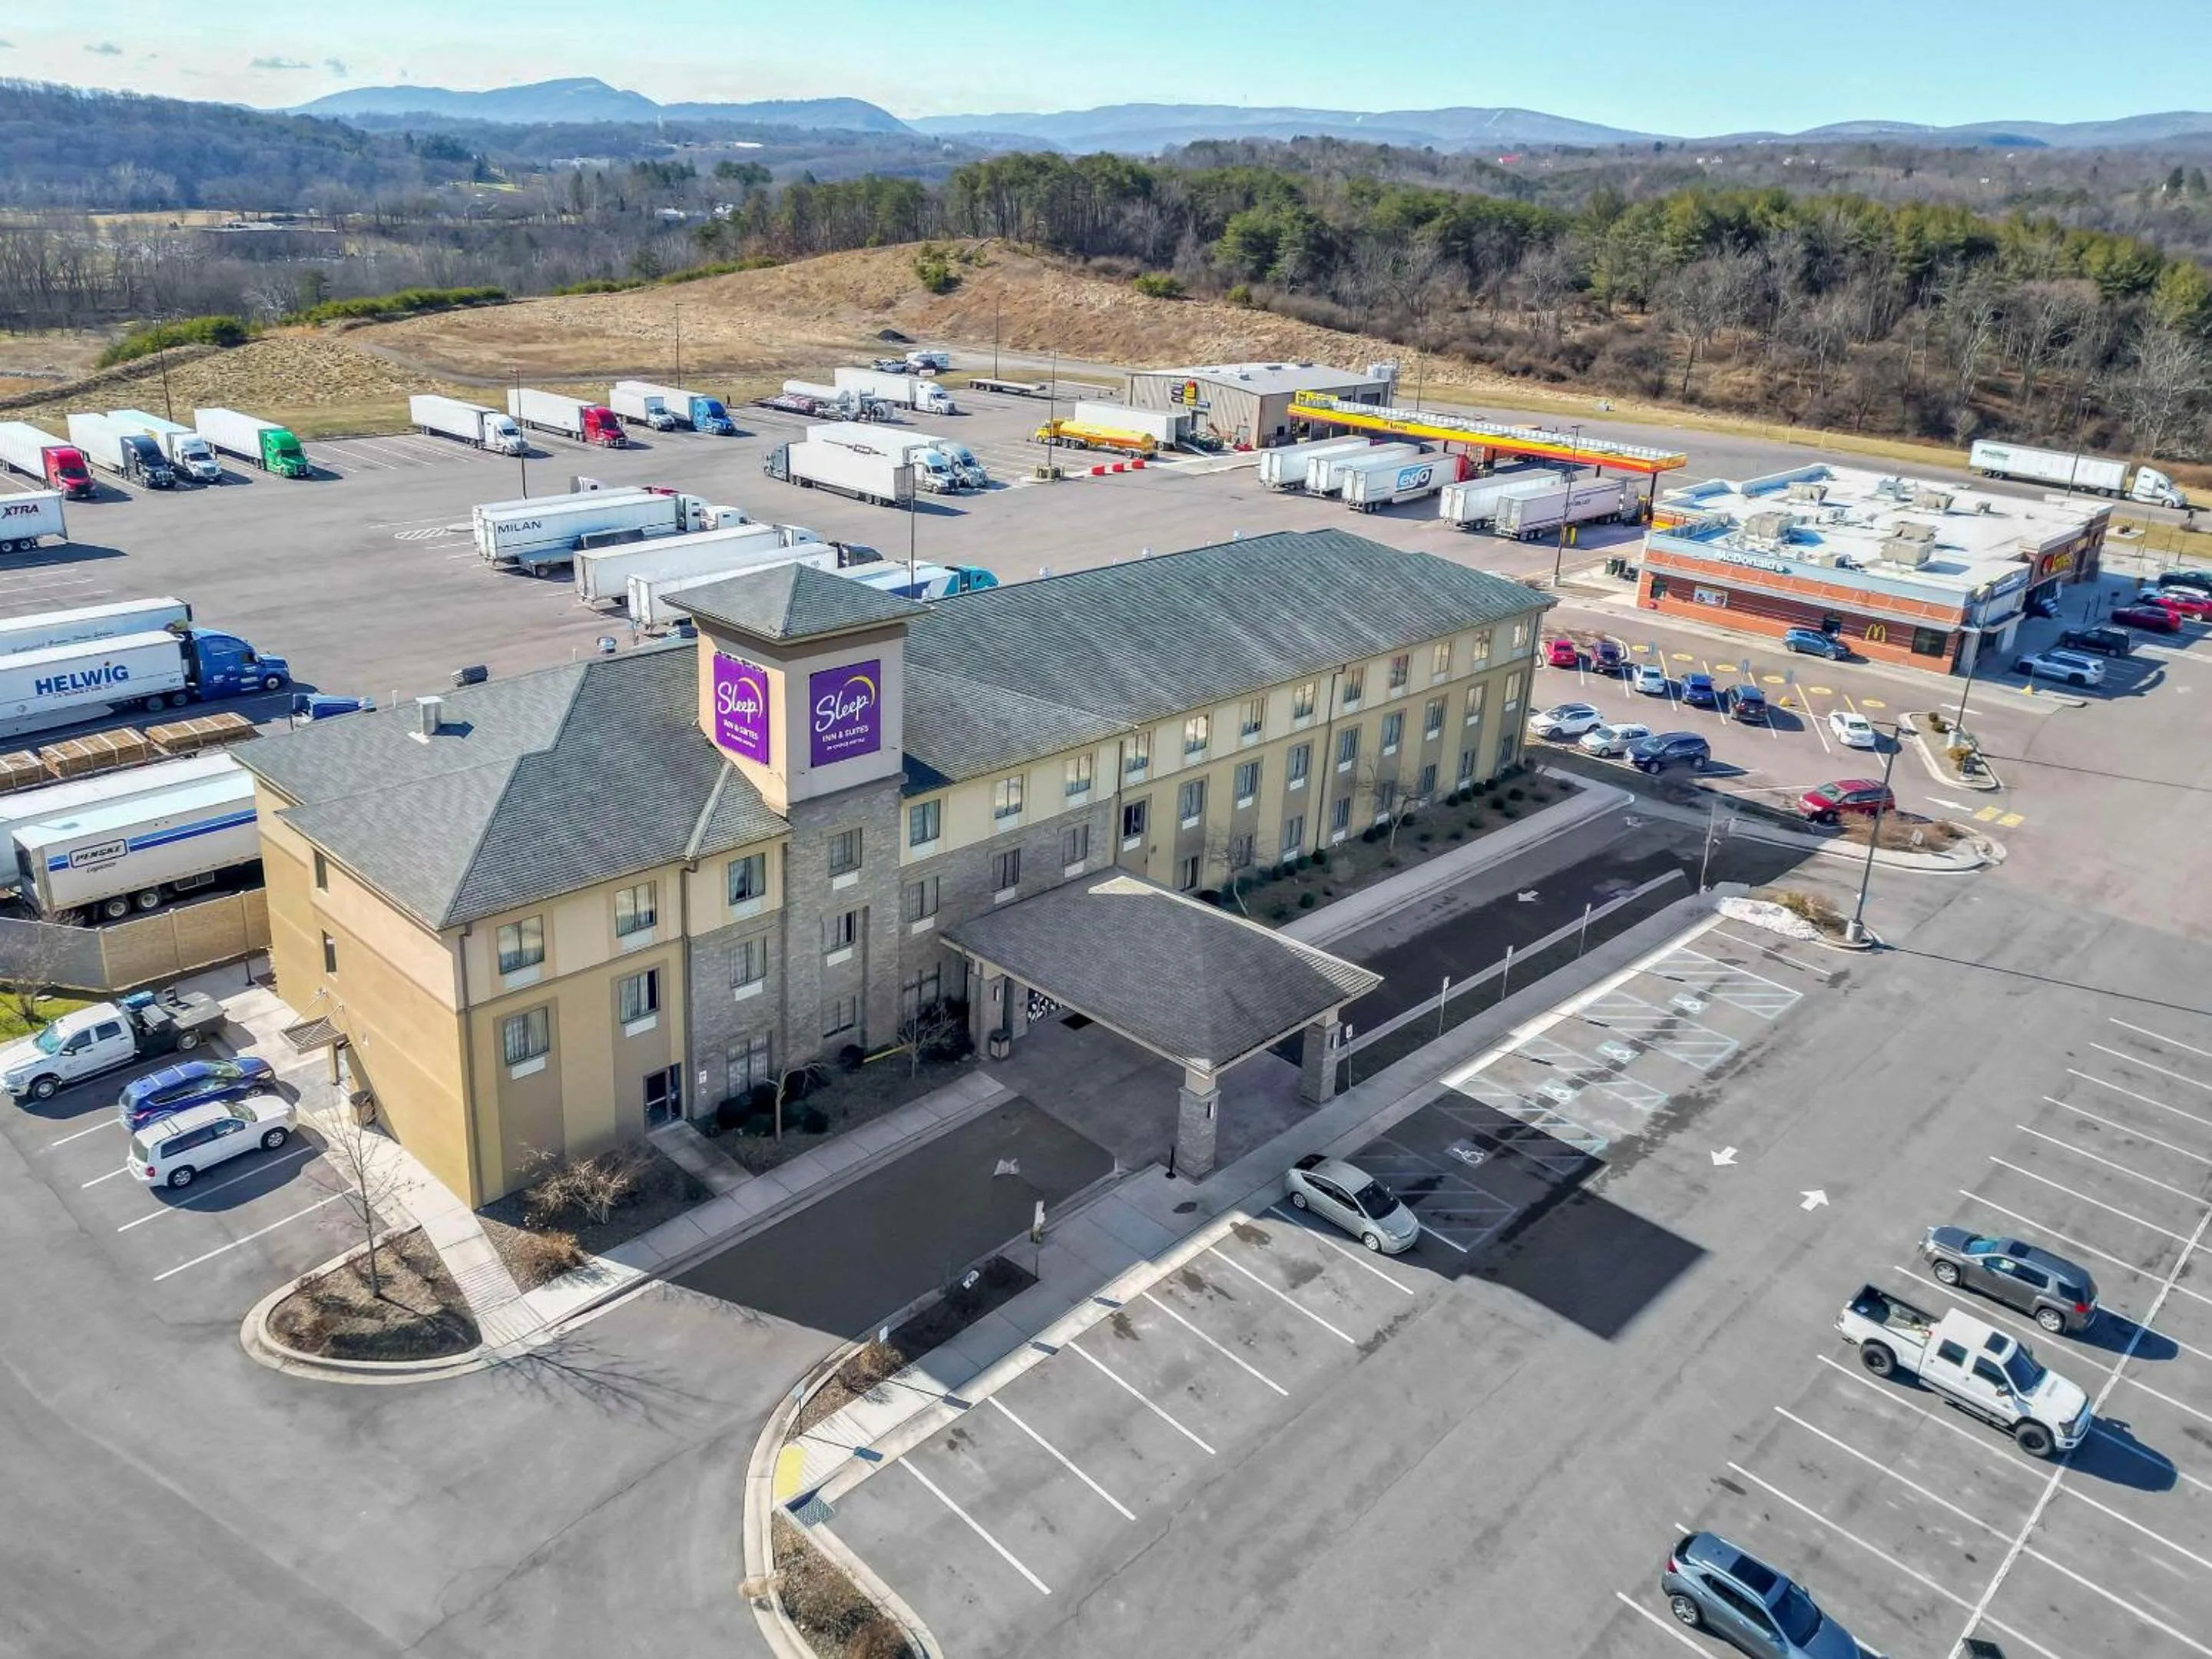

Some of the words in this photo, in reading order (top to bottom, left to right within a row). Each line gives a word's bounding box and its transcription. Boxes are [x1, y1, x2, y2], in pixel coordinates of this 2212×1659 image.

[1399, 469, 1429, 488] ego
[2, 504, 39, 519] XTRA
[498, 521, 541, 534] MILAN
[1715, 550, 1783, 571] McDonald's
[35, 663, 129, 695] HELWIG
[717, 680, 759, 724] Sleep
[815, 690, 869, 732] Sleep
[822, 733, 836, 743] INN
[845, 725, 869, 737] SUITES
